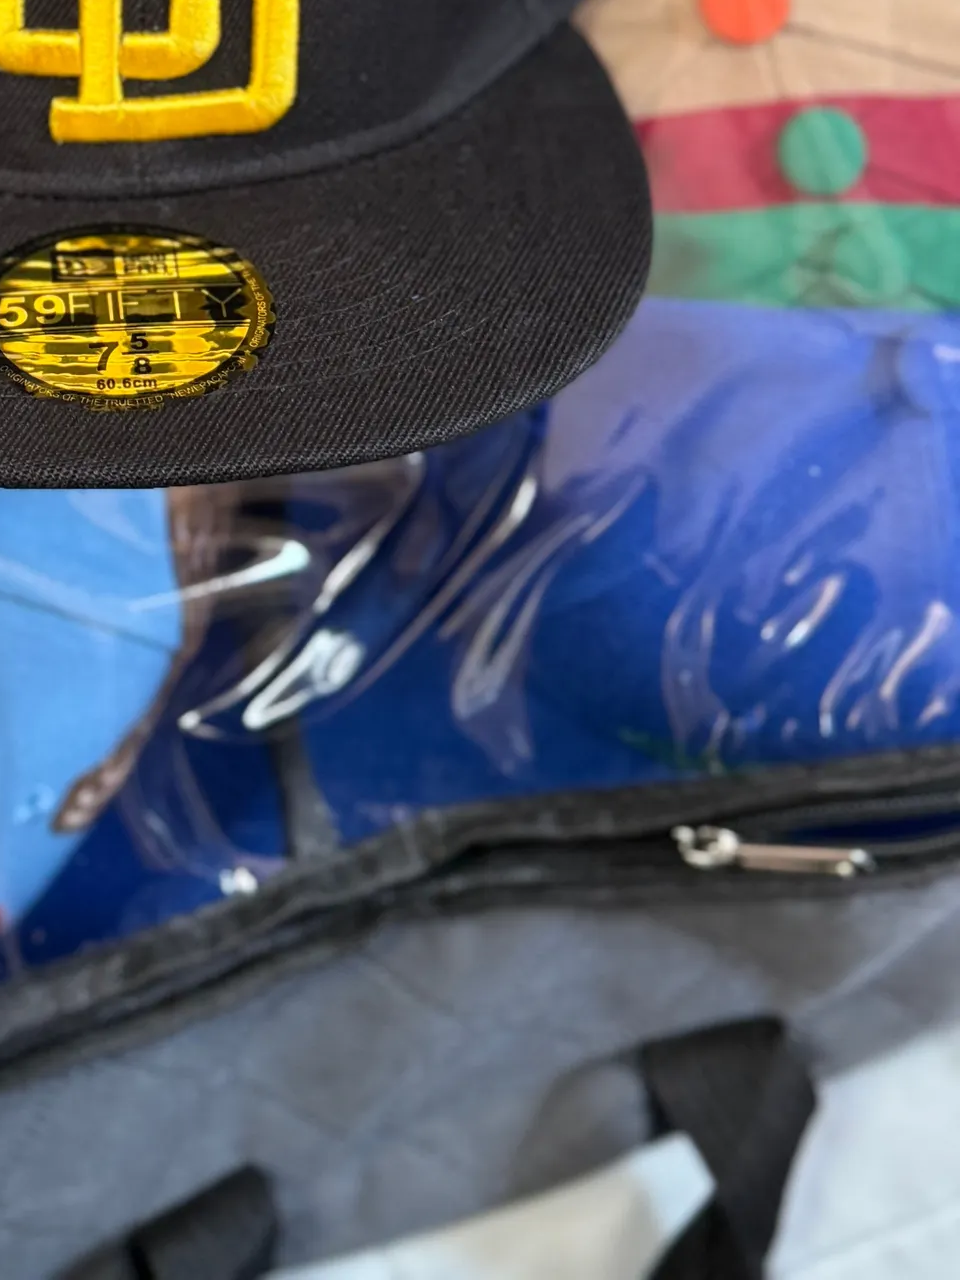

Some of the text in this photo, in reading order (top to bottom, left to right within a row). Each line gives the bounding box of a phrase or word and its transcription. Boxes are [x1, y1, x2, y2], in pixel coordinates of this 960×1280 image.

[248, 302, 267, 348] ORIGINATORS
[88, 341, 119, 371] 7
[0, 365, 60, 399] ORIGINATORS
[96, 378, 157, 390] 60.6cm
